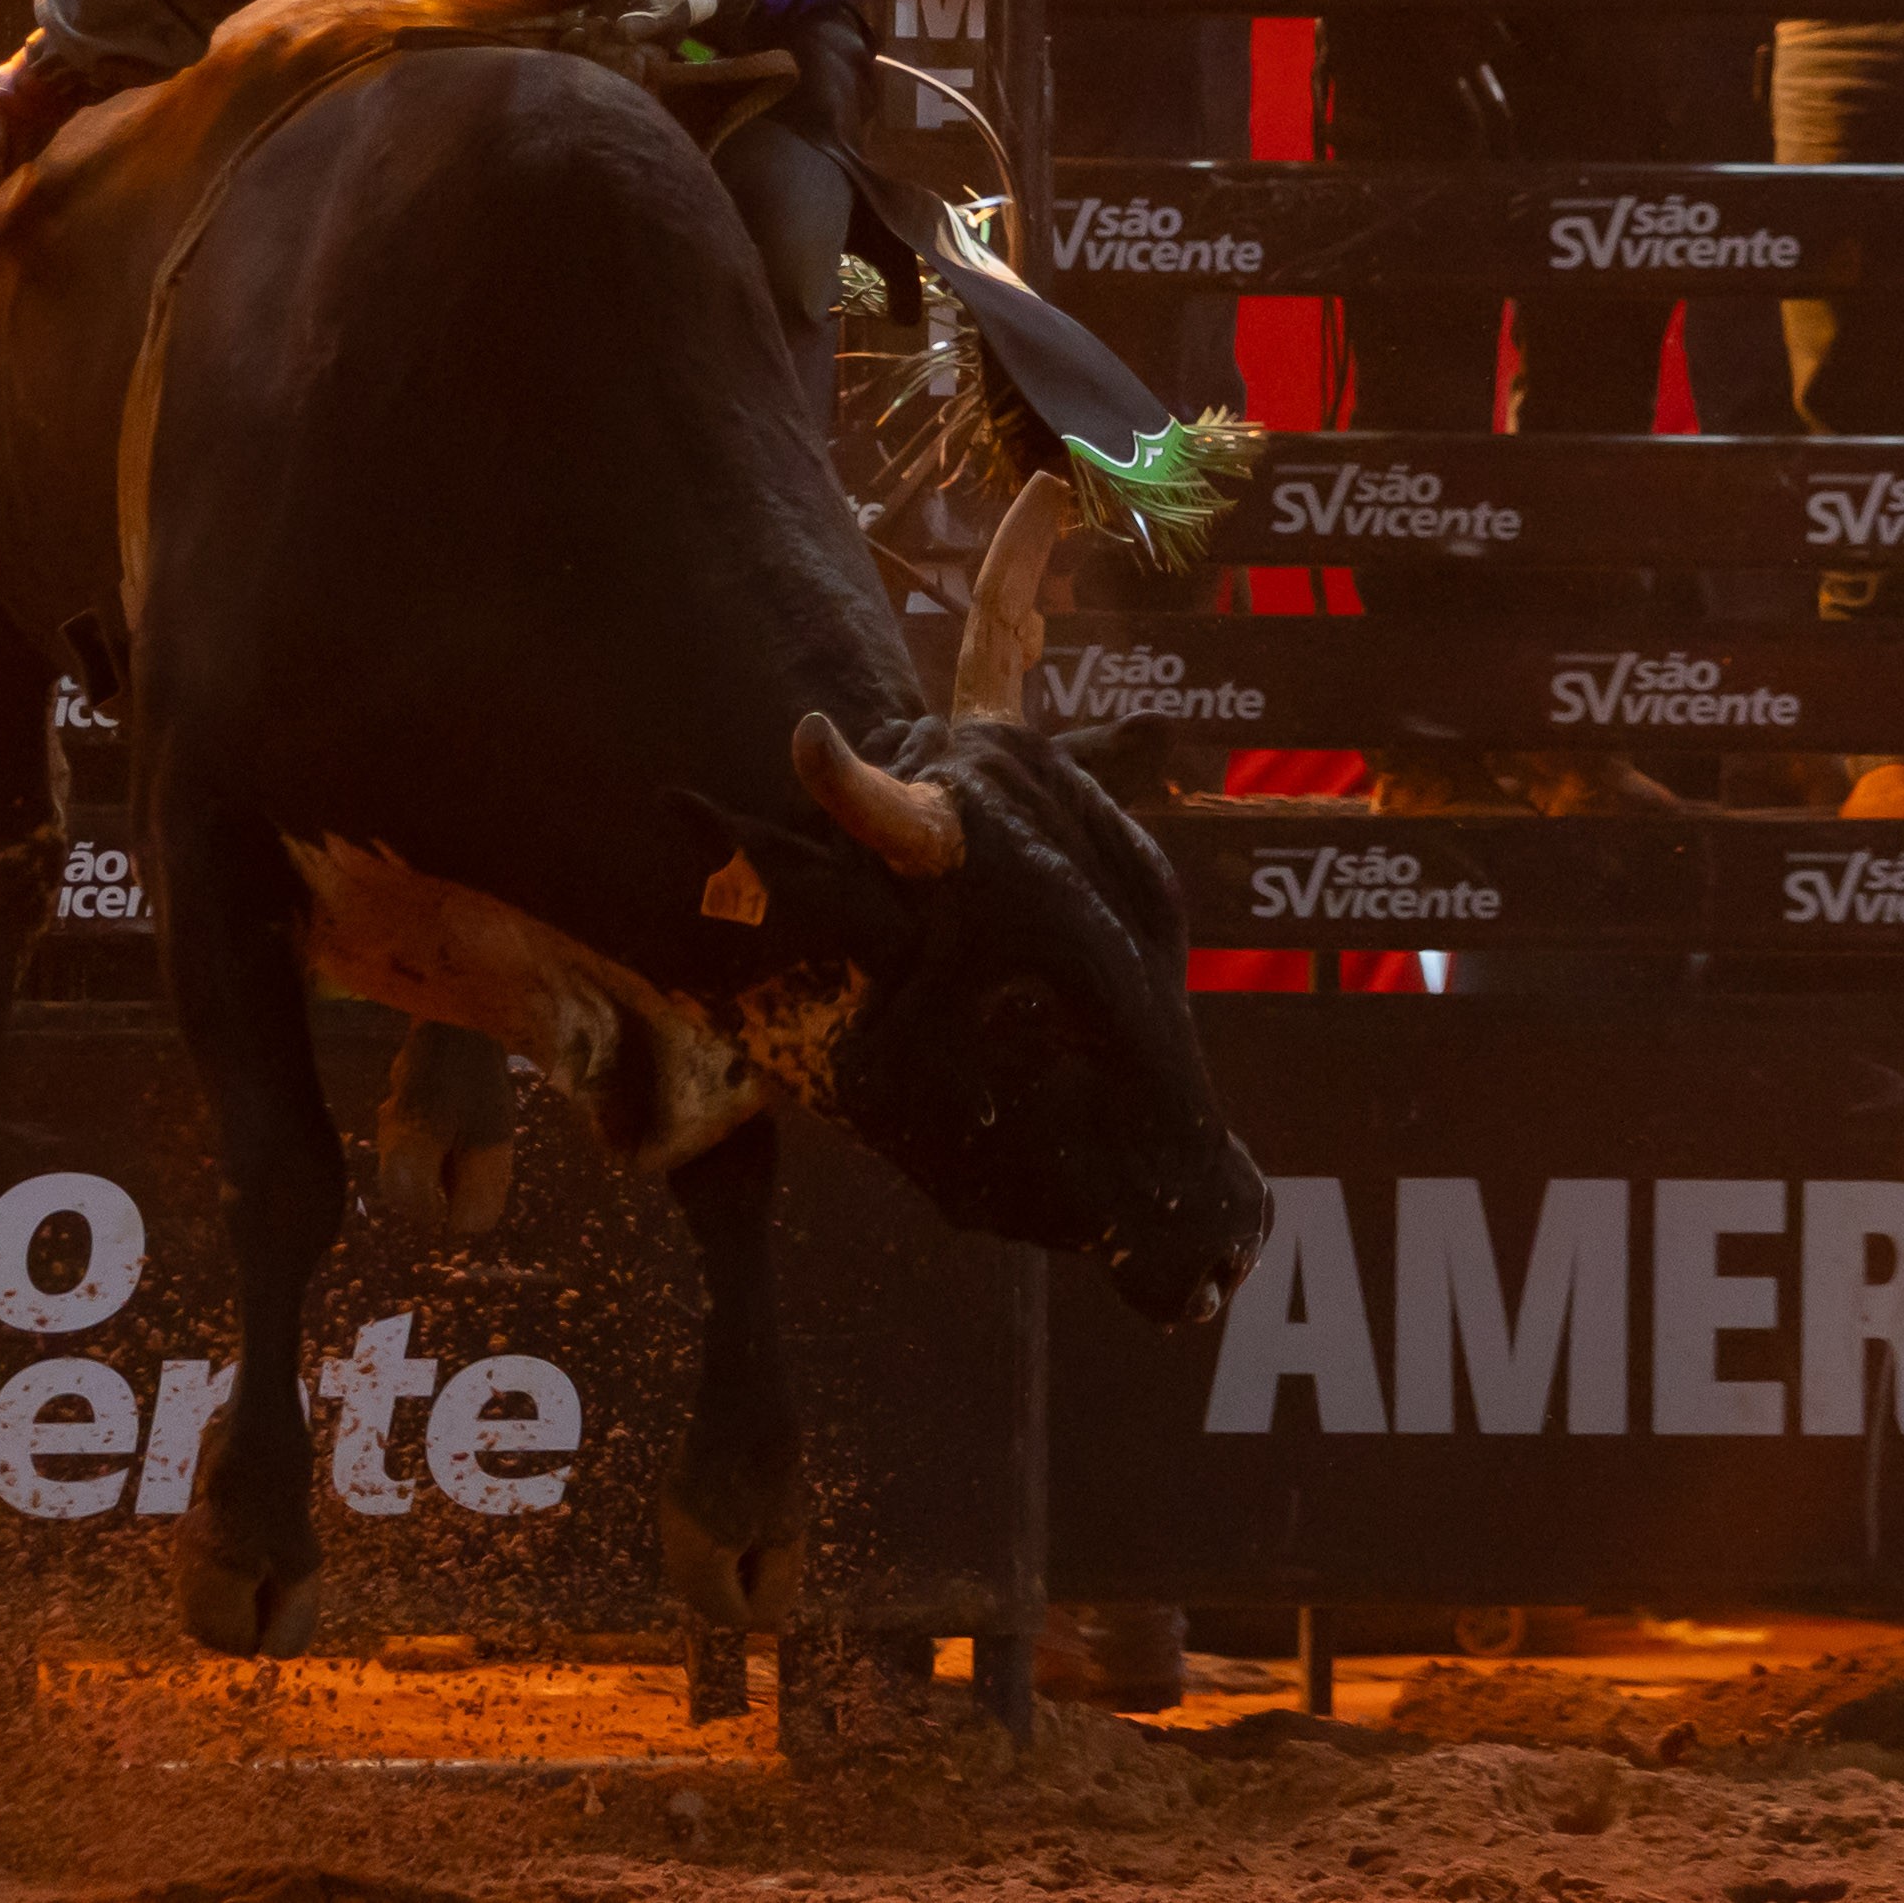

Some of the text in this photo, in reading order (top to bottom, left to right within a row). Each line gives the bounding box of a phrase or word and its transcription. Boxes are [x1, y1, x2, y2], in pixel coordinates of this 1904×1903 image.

[1096, 199, 1183, 238] são
[1633, 196, 1719, 235] são
[1085, 230, 1264, 274] vicente
[1621, 228, 1800, 270] vicente
[1098, 647, 1187, 686] são
[1633, 653, 1721, 692] são
[1087, 678, 1266, 721] vicente
[1620, 684, 1801, 727] vicente
[64, 841, 129, 882] ão
